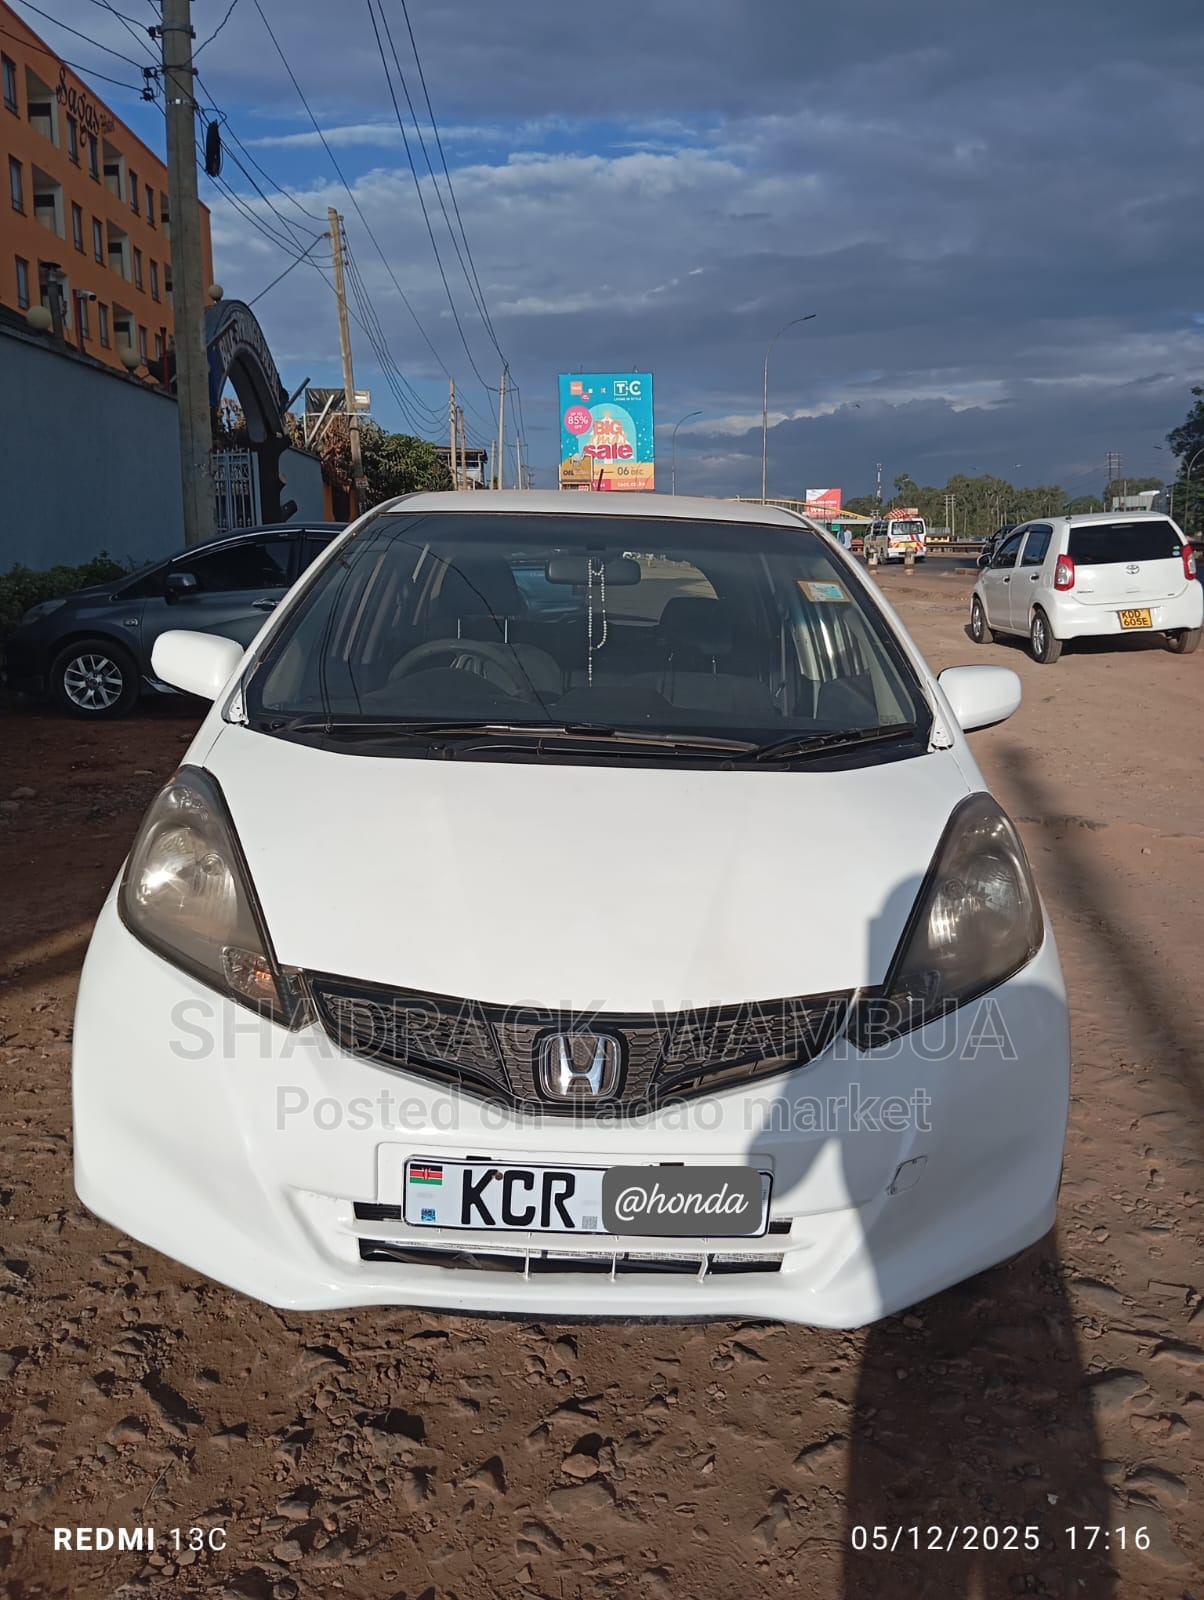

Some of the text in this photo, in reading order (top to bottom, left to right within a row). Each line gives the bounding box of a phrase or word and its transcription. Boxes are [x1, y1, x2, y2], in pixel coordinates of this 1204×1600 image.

[568, 415, 589, 425] 85%
[583, 443, 633, 459] sale
[617, 466, 630, 476] 06
[1121, 610, 1141, 619] KDD
[461, 1169, 576, 1228] KCR
